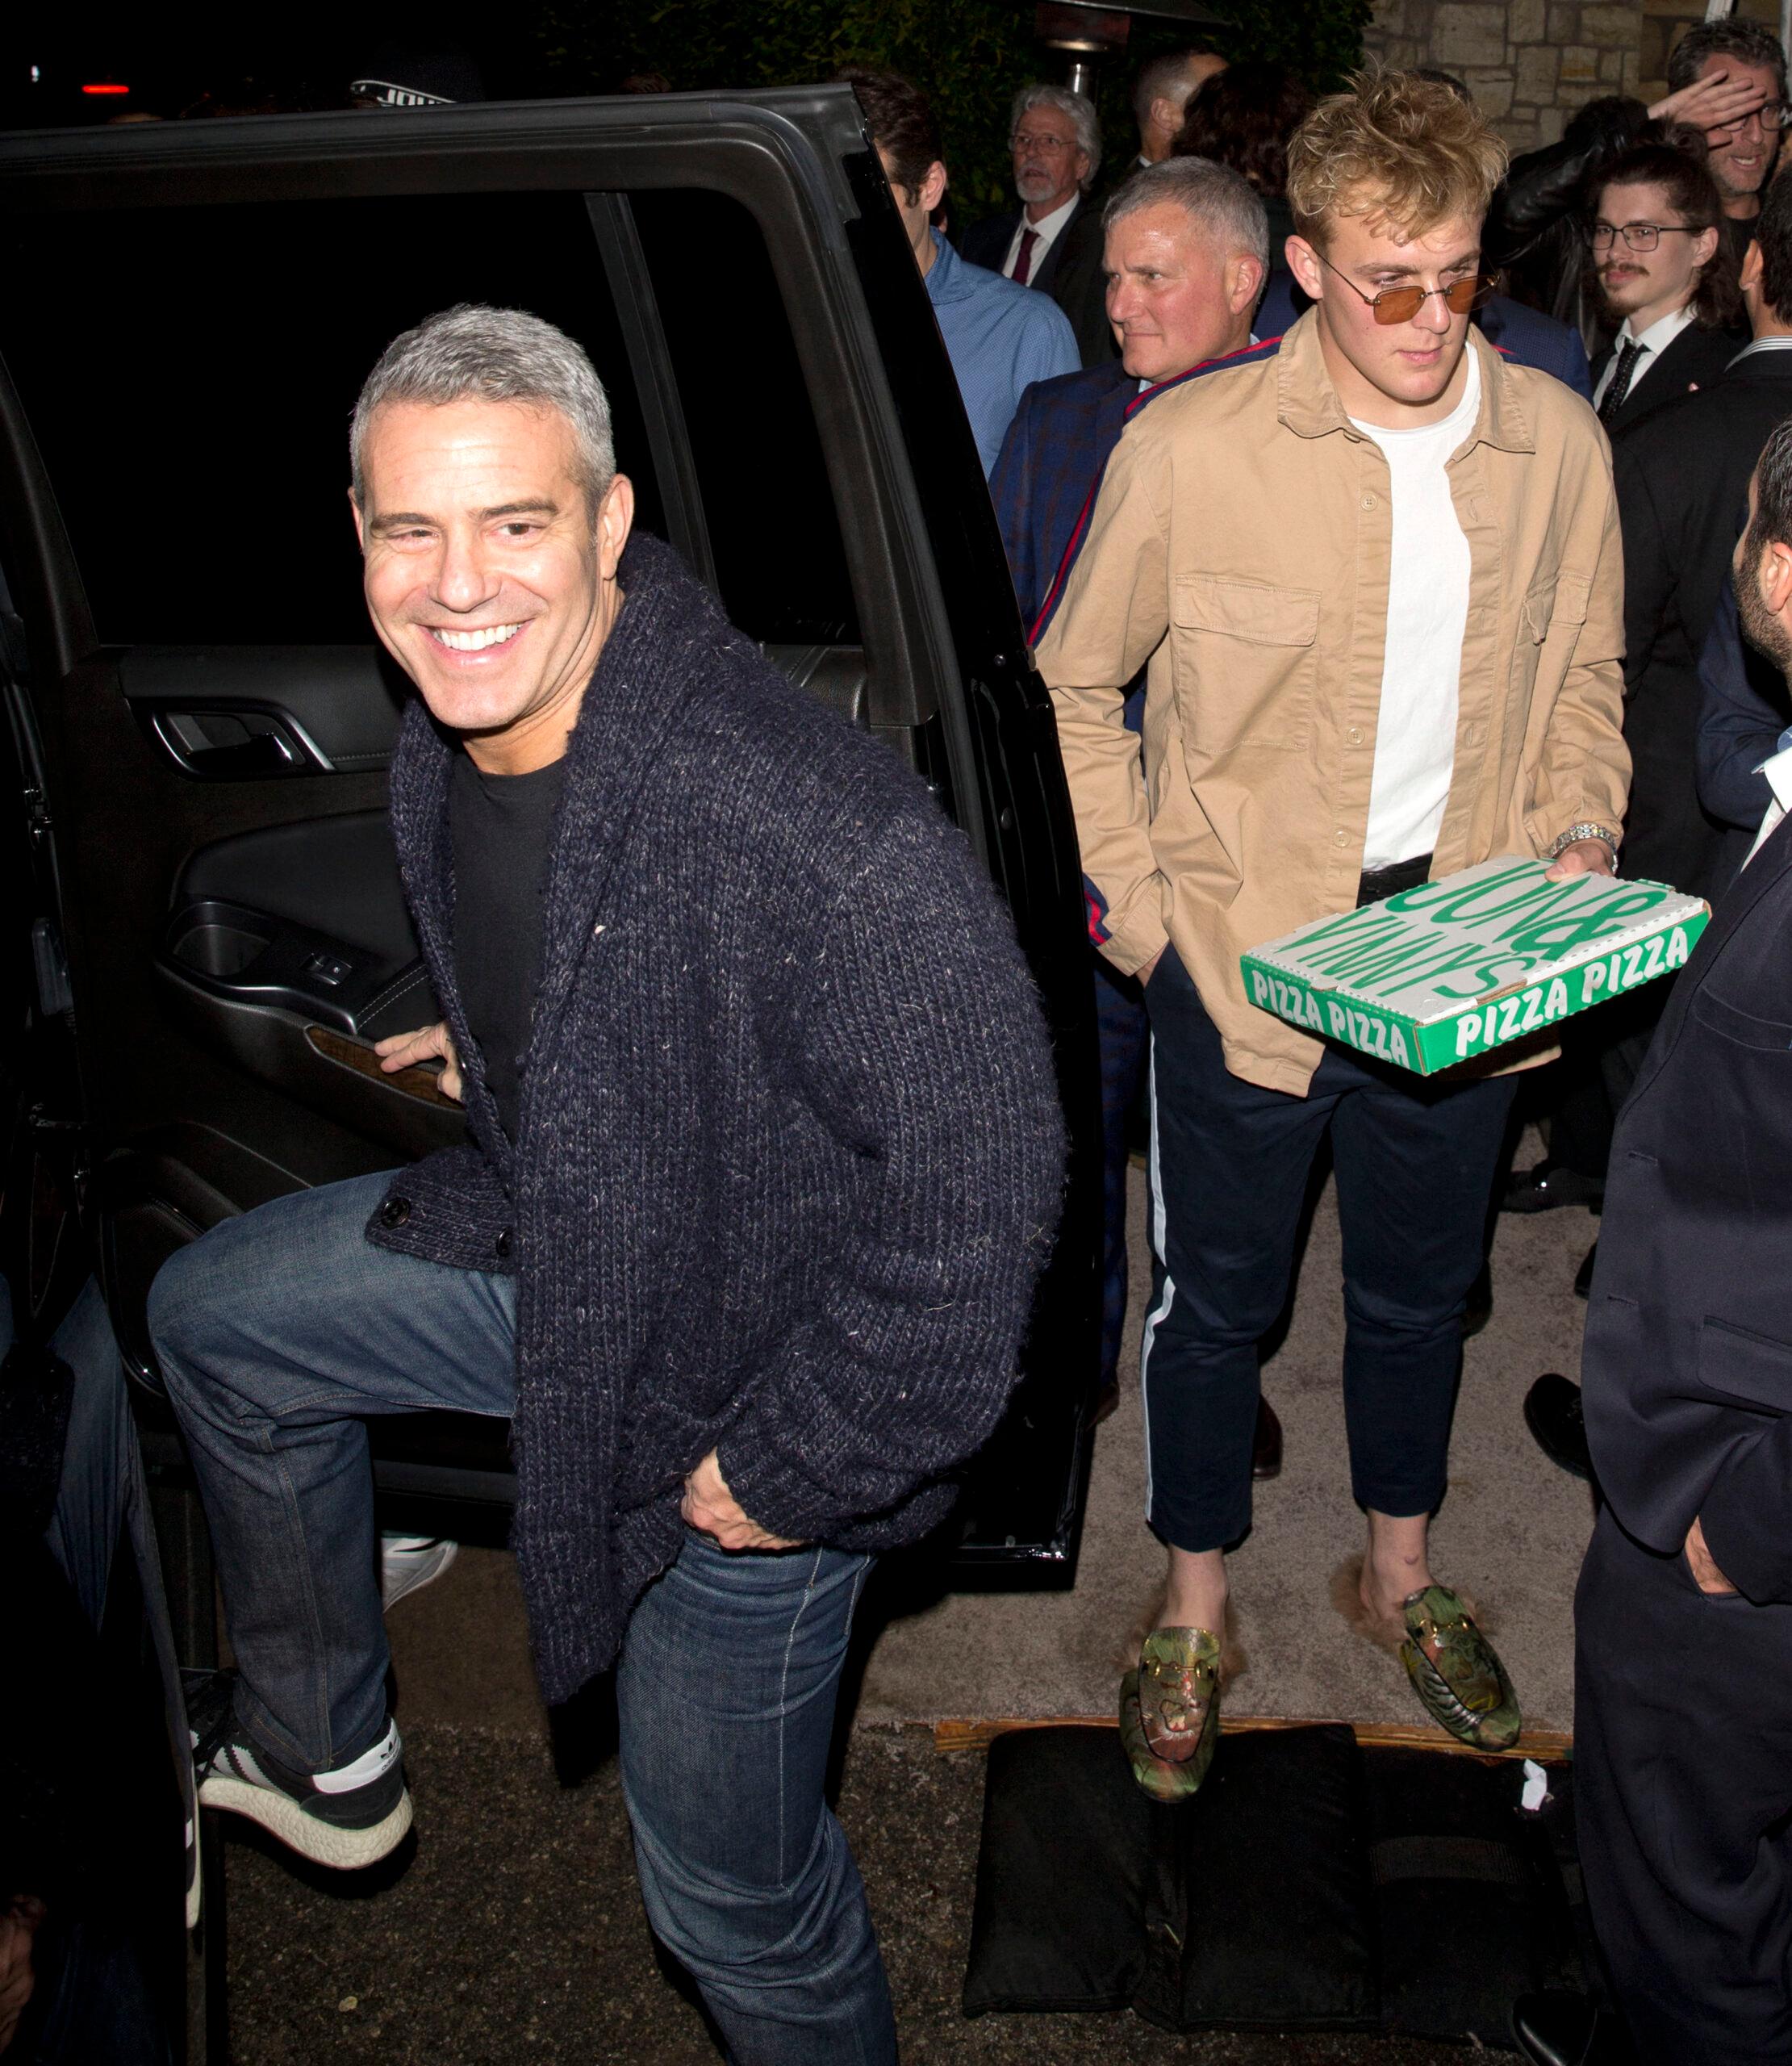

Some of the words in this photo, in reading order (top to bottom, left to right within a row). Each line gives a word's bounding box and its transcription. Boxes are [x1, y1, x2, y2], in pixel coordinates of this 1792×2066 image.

[1510, 890, 1668, 961] &
[1252, 970, 1325, 1033] PIZZA
[1327, 1001, 1410, 1069] PIZZA
[1456, 978, 1568, 1056] PIZZA
[1581, 926, 1689, 1003] PIZZA
